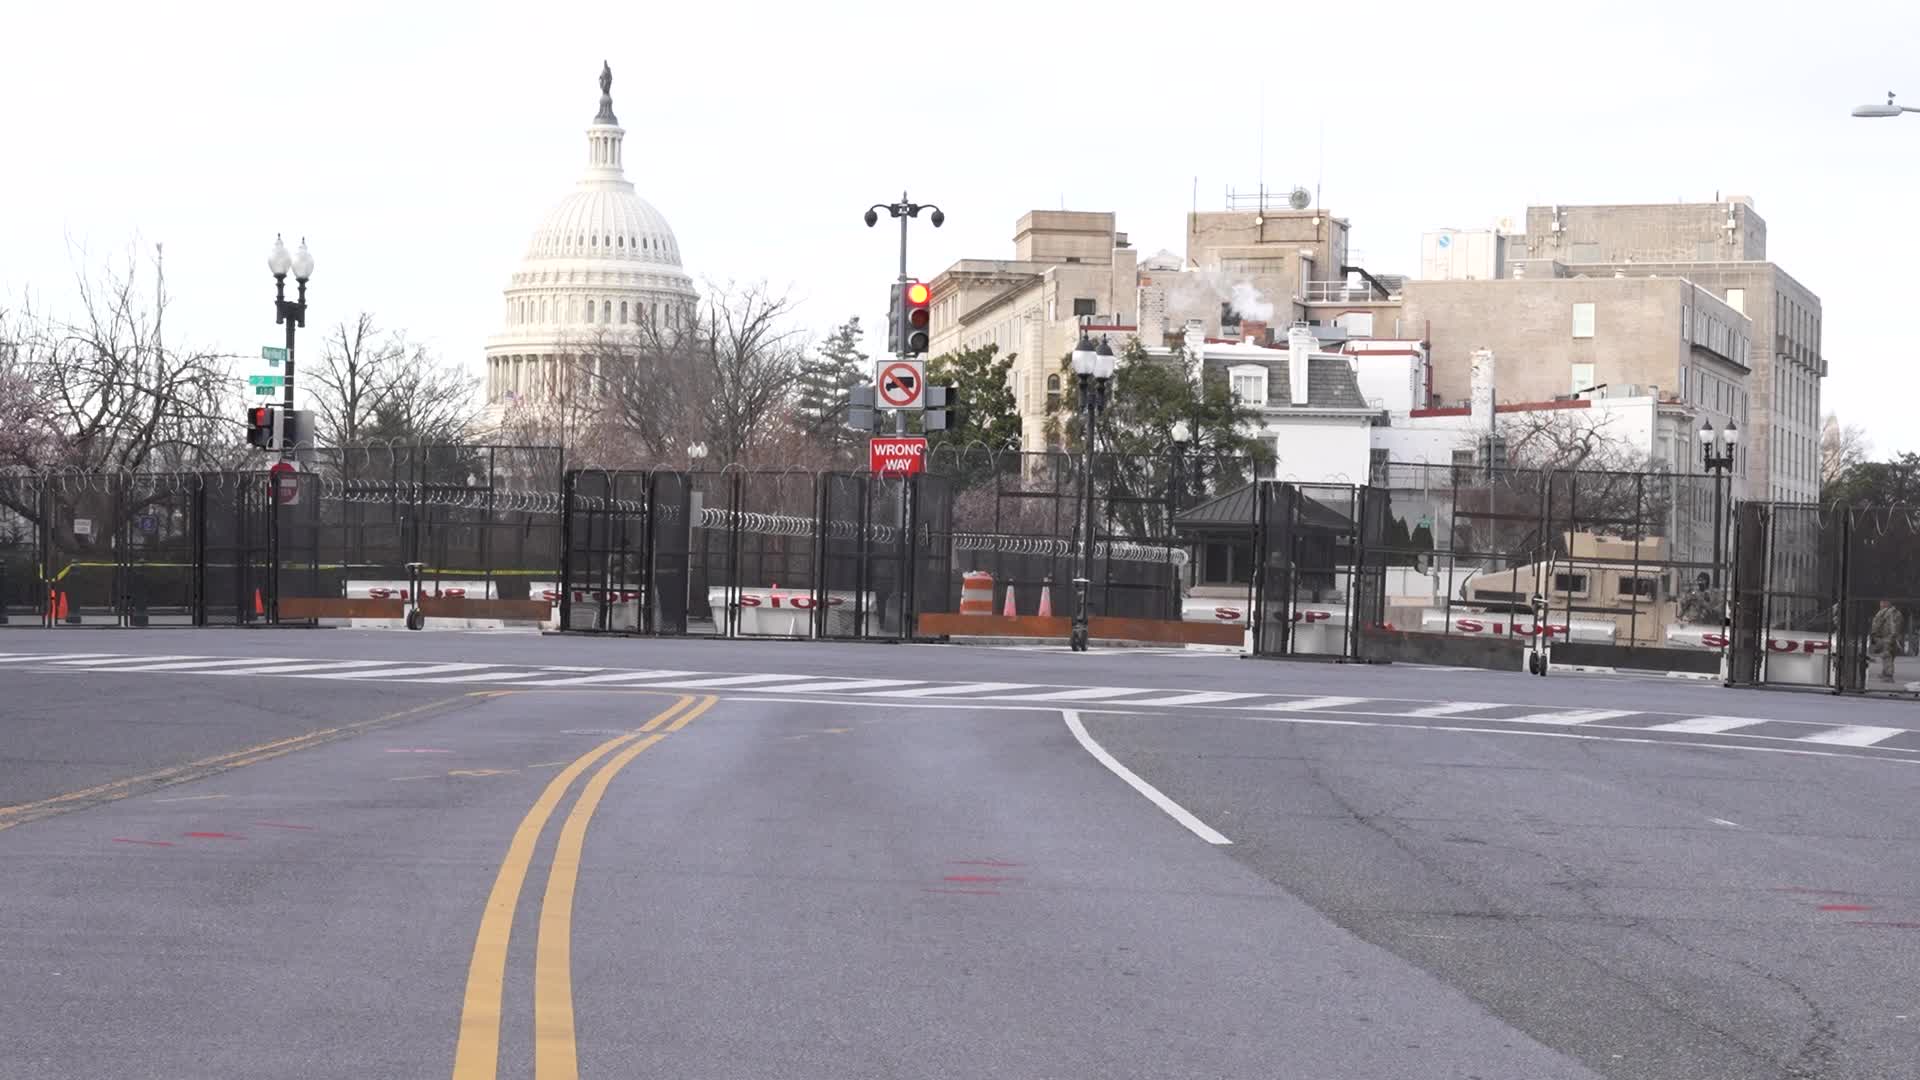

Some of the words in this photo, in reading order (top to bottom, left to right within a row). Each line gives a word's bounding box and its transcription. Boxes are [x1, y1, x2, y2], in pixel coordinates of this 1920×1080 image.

[873, 444, 923, 456] WRONG
[885, 458, 912, 470] WAY
[741, 593, 844, 608] STOP
[1456, 619, 1568, 638] STOP
[1702, 633, 1831, 653] SOP
